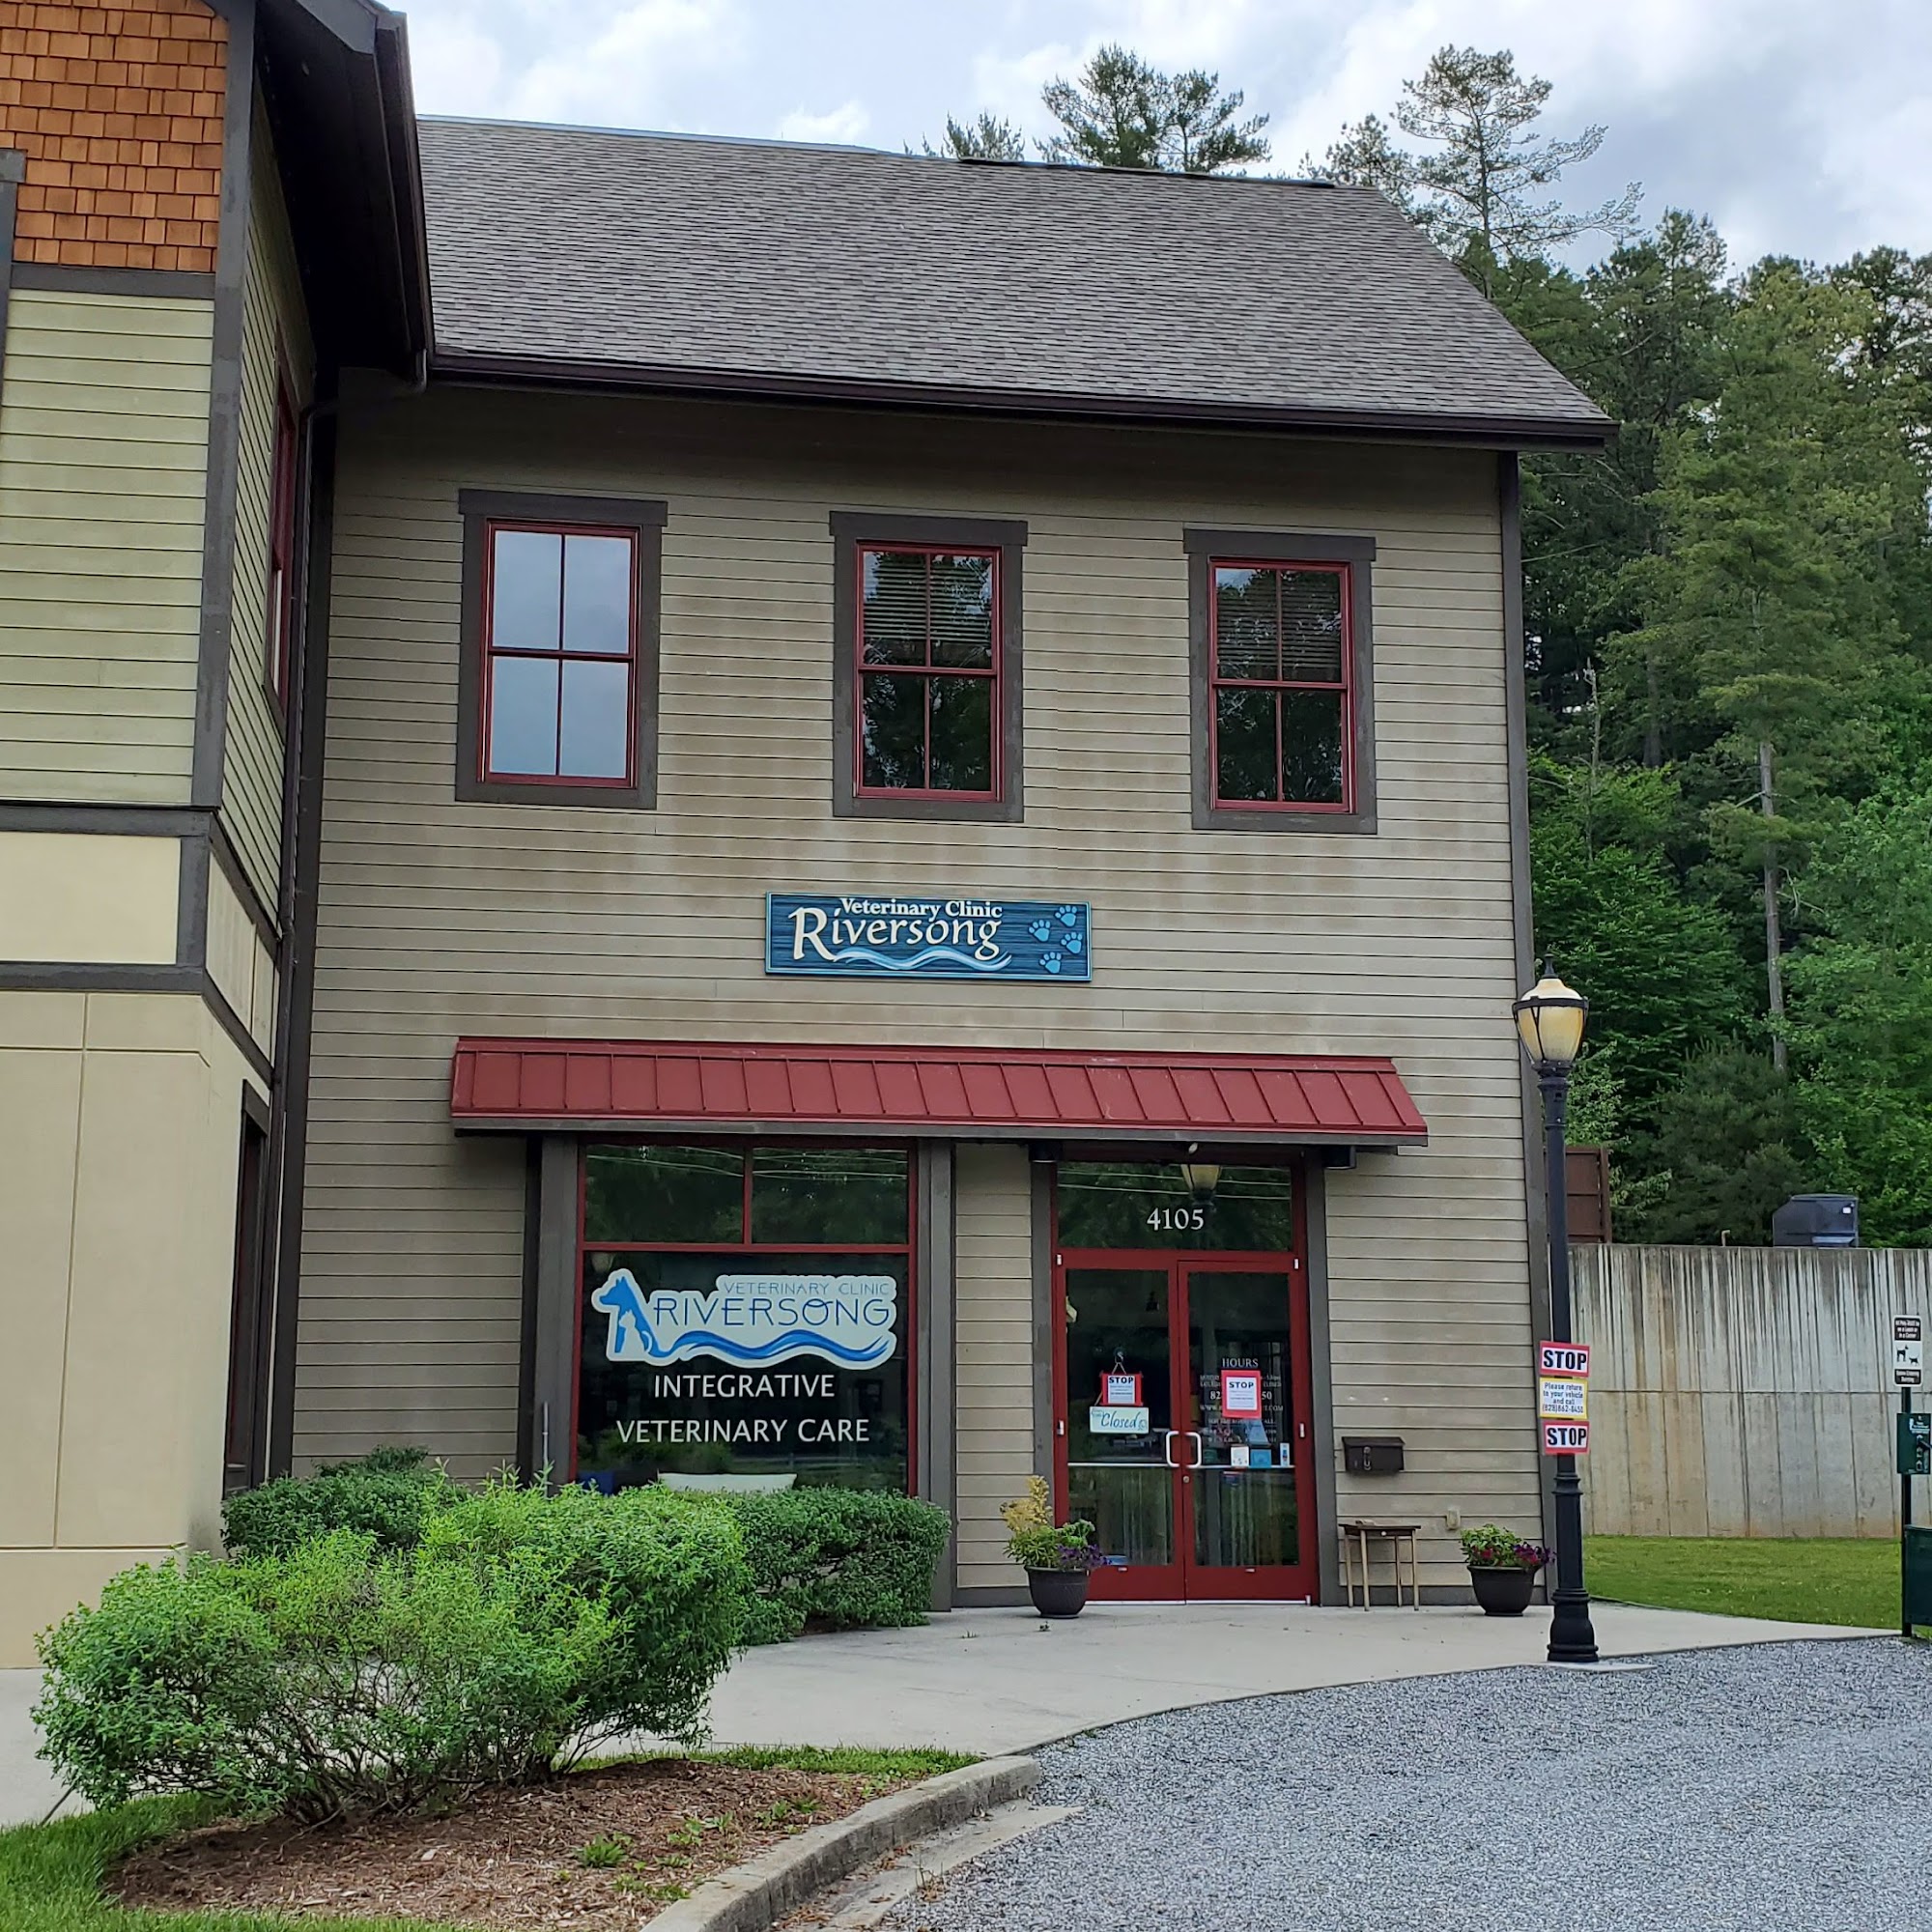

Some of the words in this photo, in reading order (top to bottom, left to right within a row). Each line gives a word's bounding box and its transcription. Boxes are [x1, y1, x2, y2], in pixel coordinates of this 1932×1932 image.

[839, 897, 942, 922] Veterinary
[945, 900, 1003, 919] Clinic
[788, 907, 1003, 961] Riversong
[1147, 1208, 1205, 1231] 4105
[724, 1282, 828, 1294] VETERINARY
[838, 1283, 890, 1295] CLINIC
[653, 1297, 889, 1327] RIVERSONG
[1222, 1358, 1259, 1368] HOURS
[1543, 1350, 1586, 1370] STOP
[654, 1374, 835, 1398] INTEGRATIVE
[616, 1419, 788, 1443] VETERINARY
[798, 1418, 869, 1442] CARE
[1101, 1410, 1141, 1428] Closed
[1547, 1427, 1586, 1446] STOP
